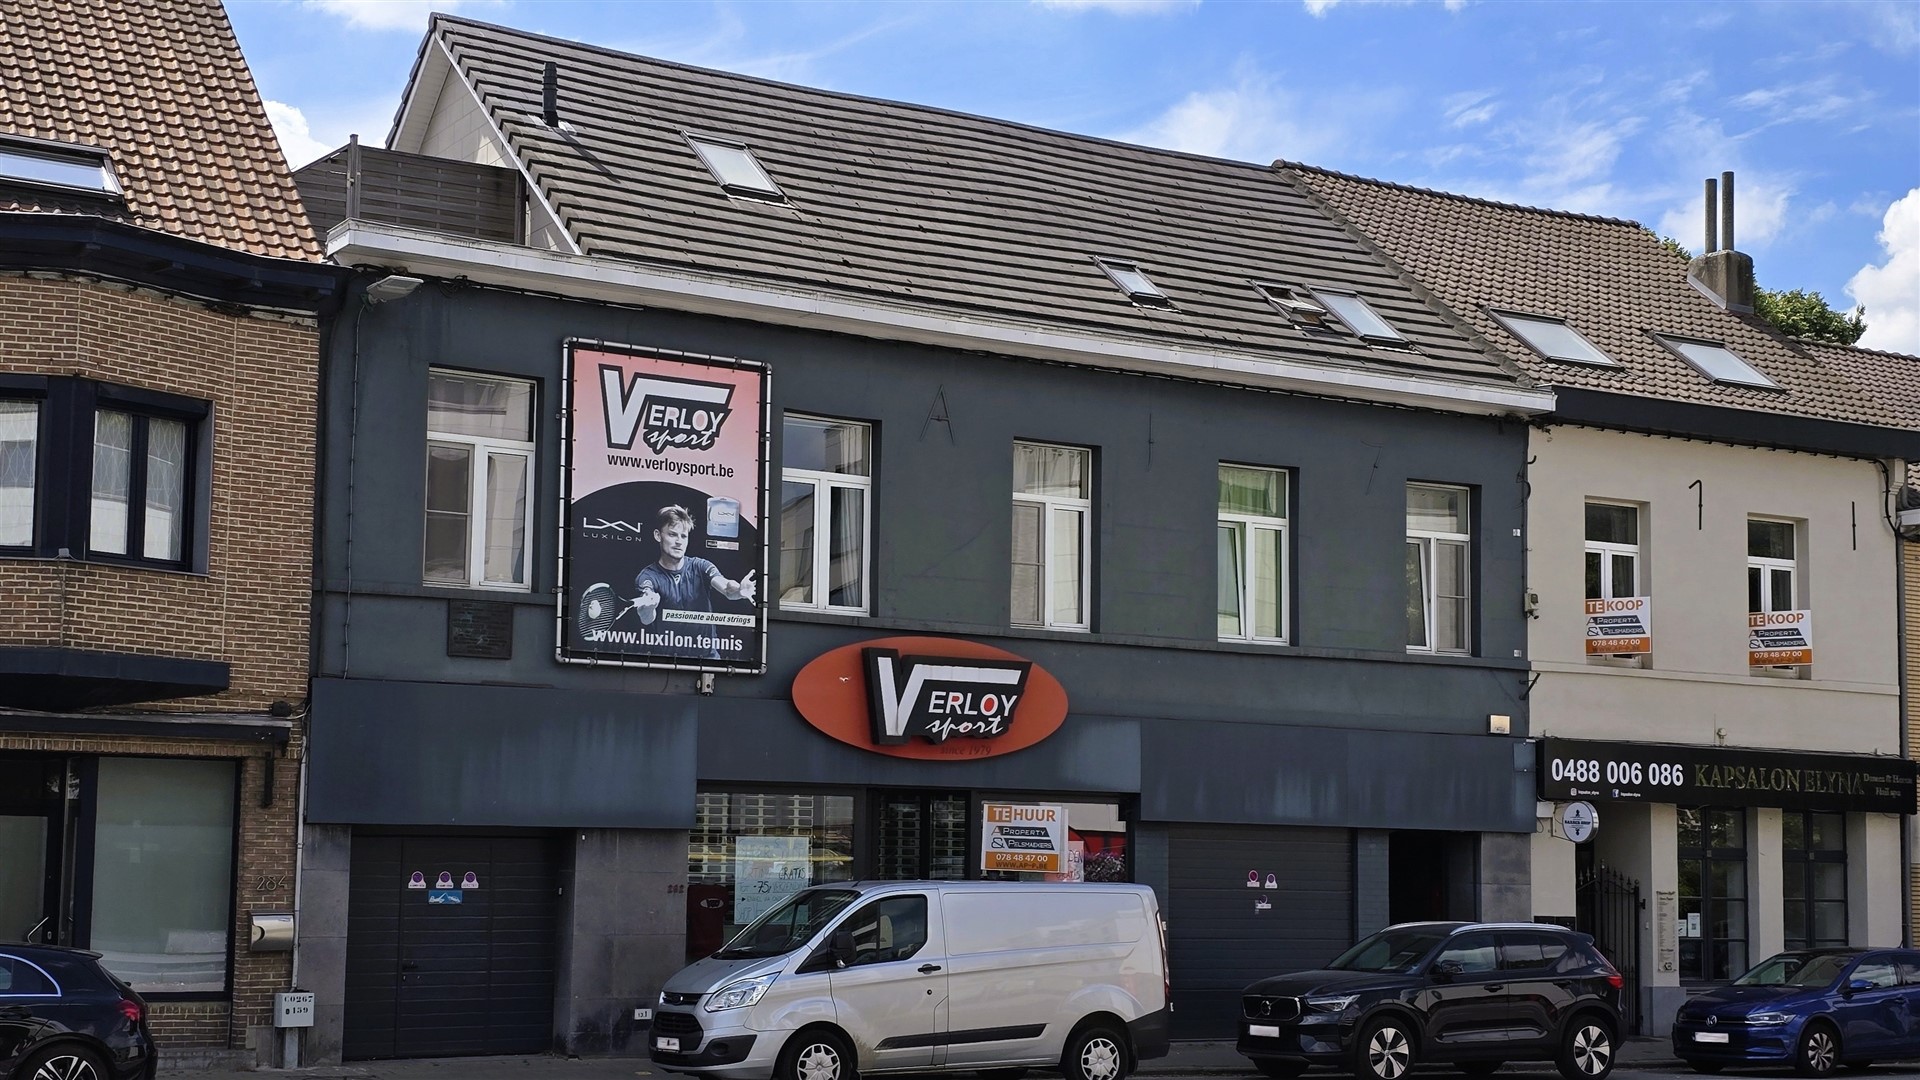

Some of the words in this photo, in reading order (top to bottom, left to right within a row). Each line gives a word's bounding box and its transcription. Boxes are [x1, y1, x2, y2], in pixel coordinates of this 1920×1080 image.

[601, 365, 734, 447] VERLOY
[647, 428, 714, 452] sport
[607, 454, 734, 478] www.verloysport.be
[583, 532, 642, 542] LUXILON
[1587, 601, 1603, 613] TE
[1607, 600, 1644, 612] KOOP
[664, 611, 704, 621] passionate
[705, 613, 726, 622] about
[726, 615, 751, 625] strings
[1749, 615, 1764, 626] TE
[1767, 613, 1804, 624] KOOP
[592, 628, 743, 651] www.luxilon.tennis
[1630, 638, 1641, 646] 00
[877, 656, 1022, 737] VERLOY
[925, 714, 1003, 741] sport
[1551, 758, 1600, 783] 0488
[1606, 761, 1643, 785] 006
[1648, 763, 1684, 787] 086
[1694, 764, 1800, 792] KAPSALON
[1804, 769, 1865, 795] ELYNA
[993, 807, 1011, 820] TE
[1014, 809, 1056, 822] HUUR
[1002, 827, 1046, 836] PROPERTY
[996, 853, 1012, 861] 078
[778, 866, 806, 880] GRATIS
